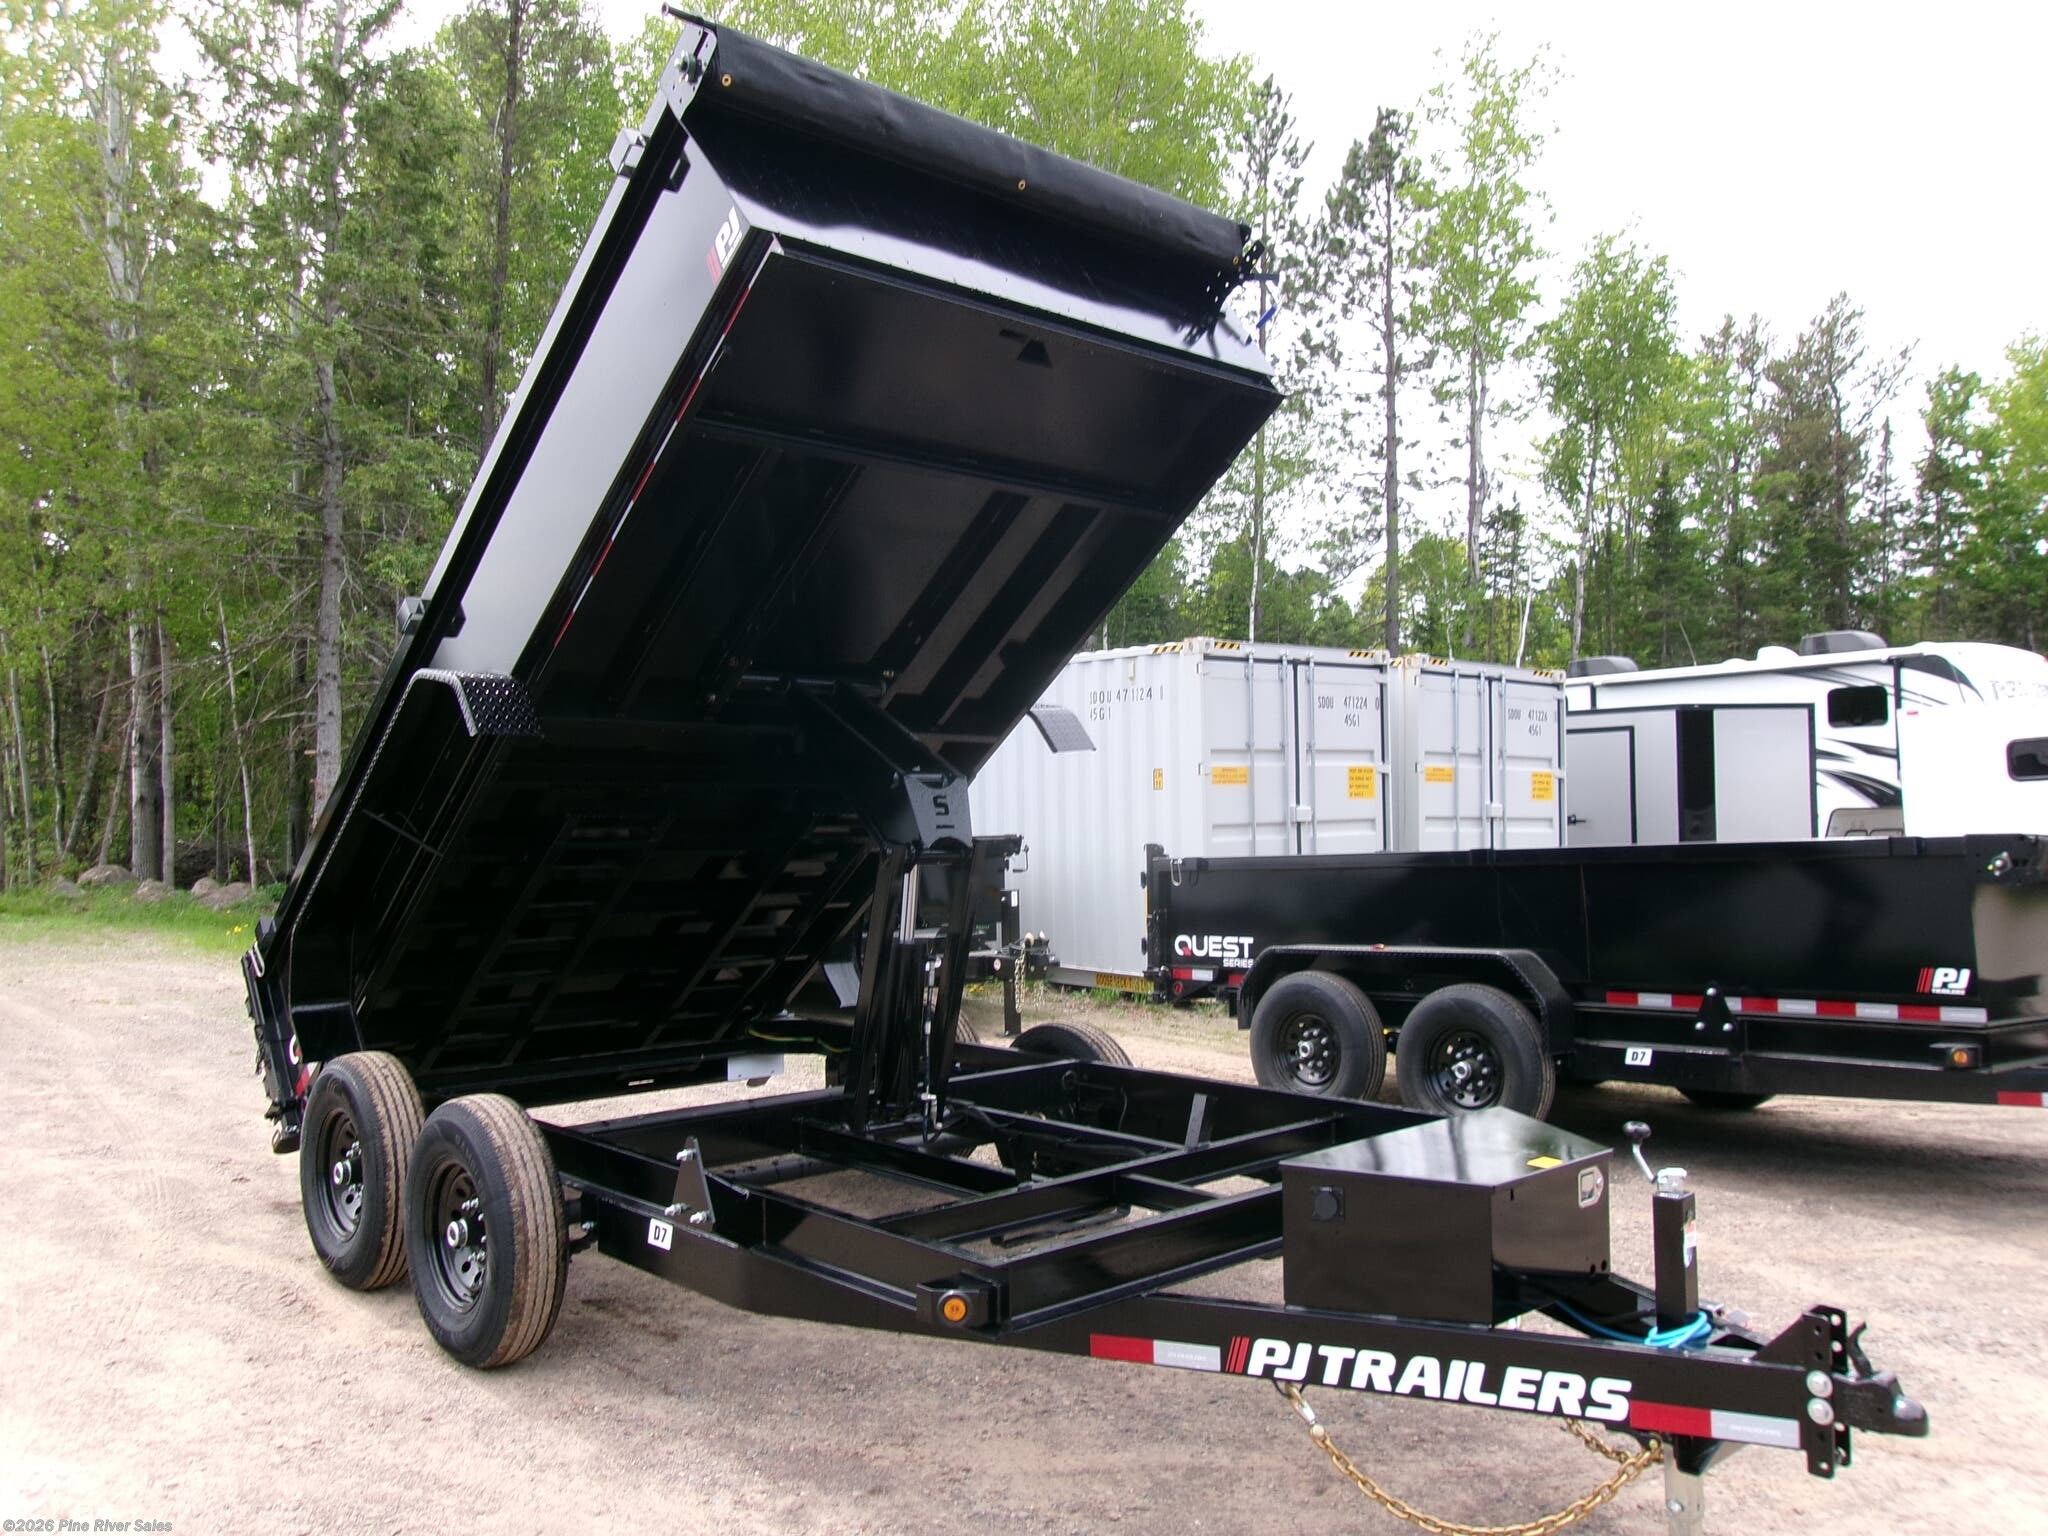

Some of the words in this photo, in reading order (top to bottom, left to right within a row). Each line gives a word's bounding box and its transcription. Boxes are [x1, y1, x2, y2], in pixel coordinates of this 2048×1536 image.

[715, 205, 740, 264] PJ
[1174, 934, 1254, 958] QUEST
[1223, 958, 1254, 968] SERIES
[1932, 967, 1971, 989] PJ
[1632, 1051, 1646, 1062] D7
[654, 1225, 667, 1243] D7
[1247, 1338, 1313, 1382] PJ
[1318, 1345, 1632, 1422] TRAILERS
